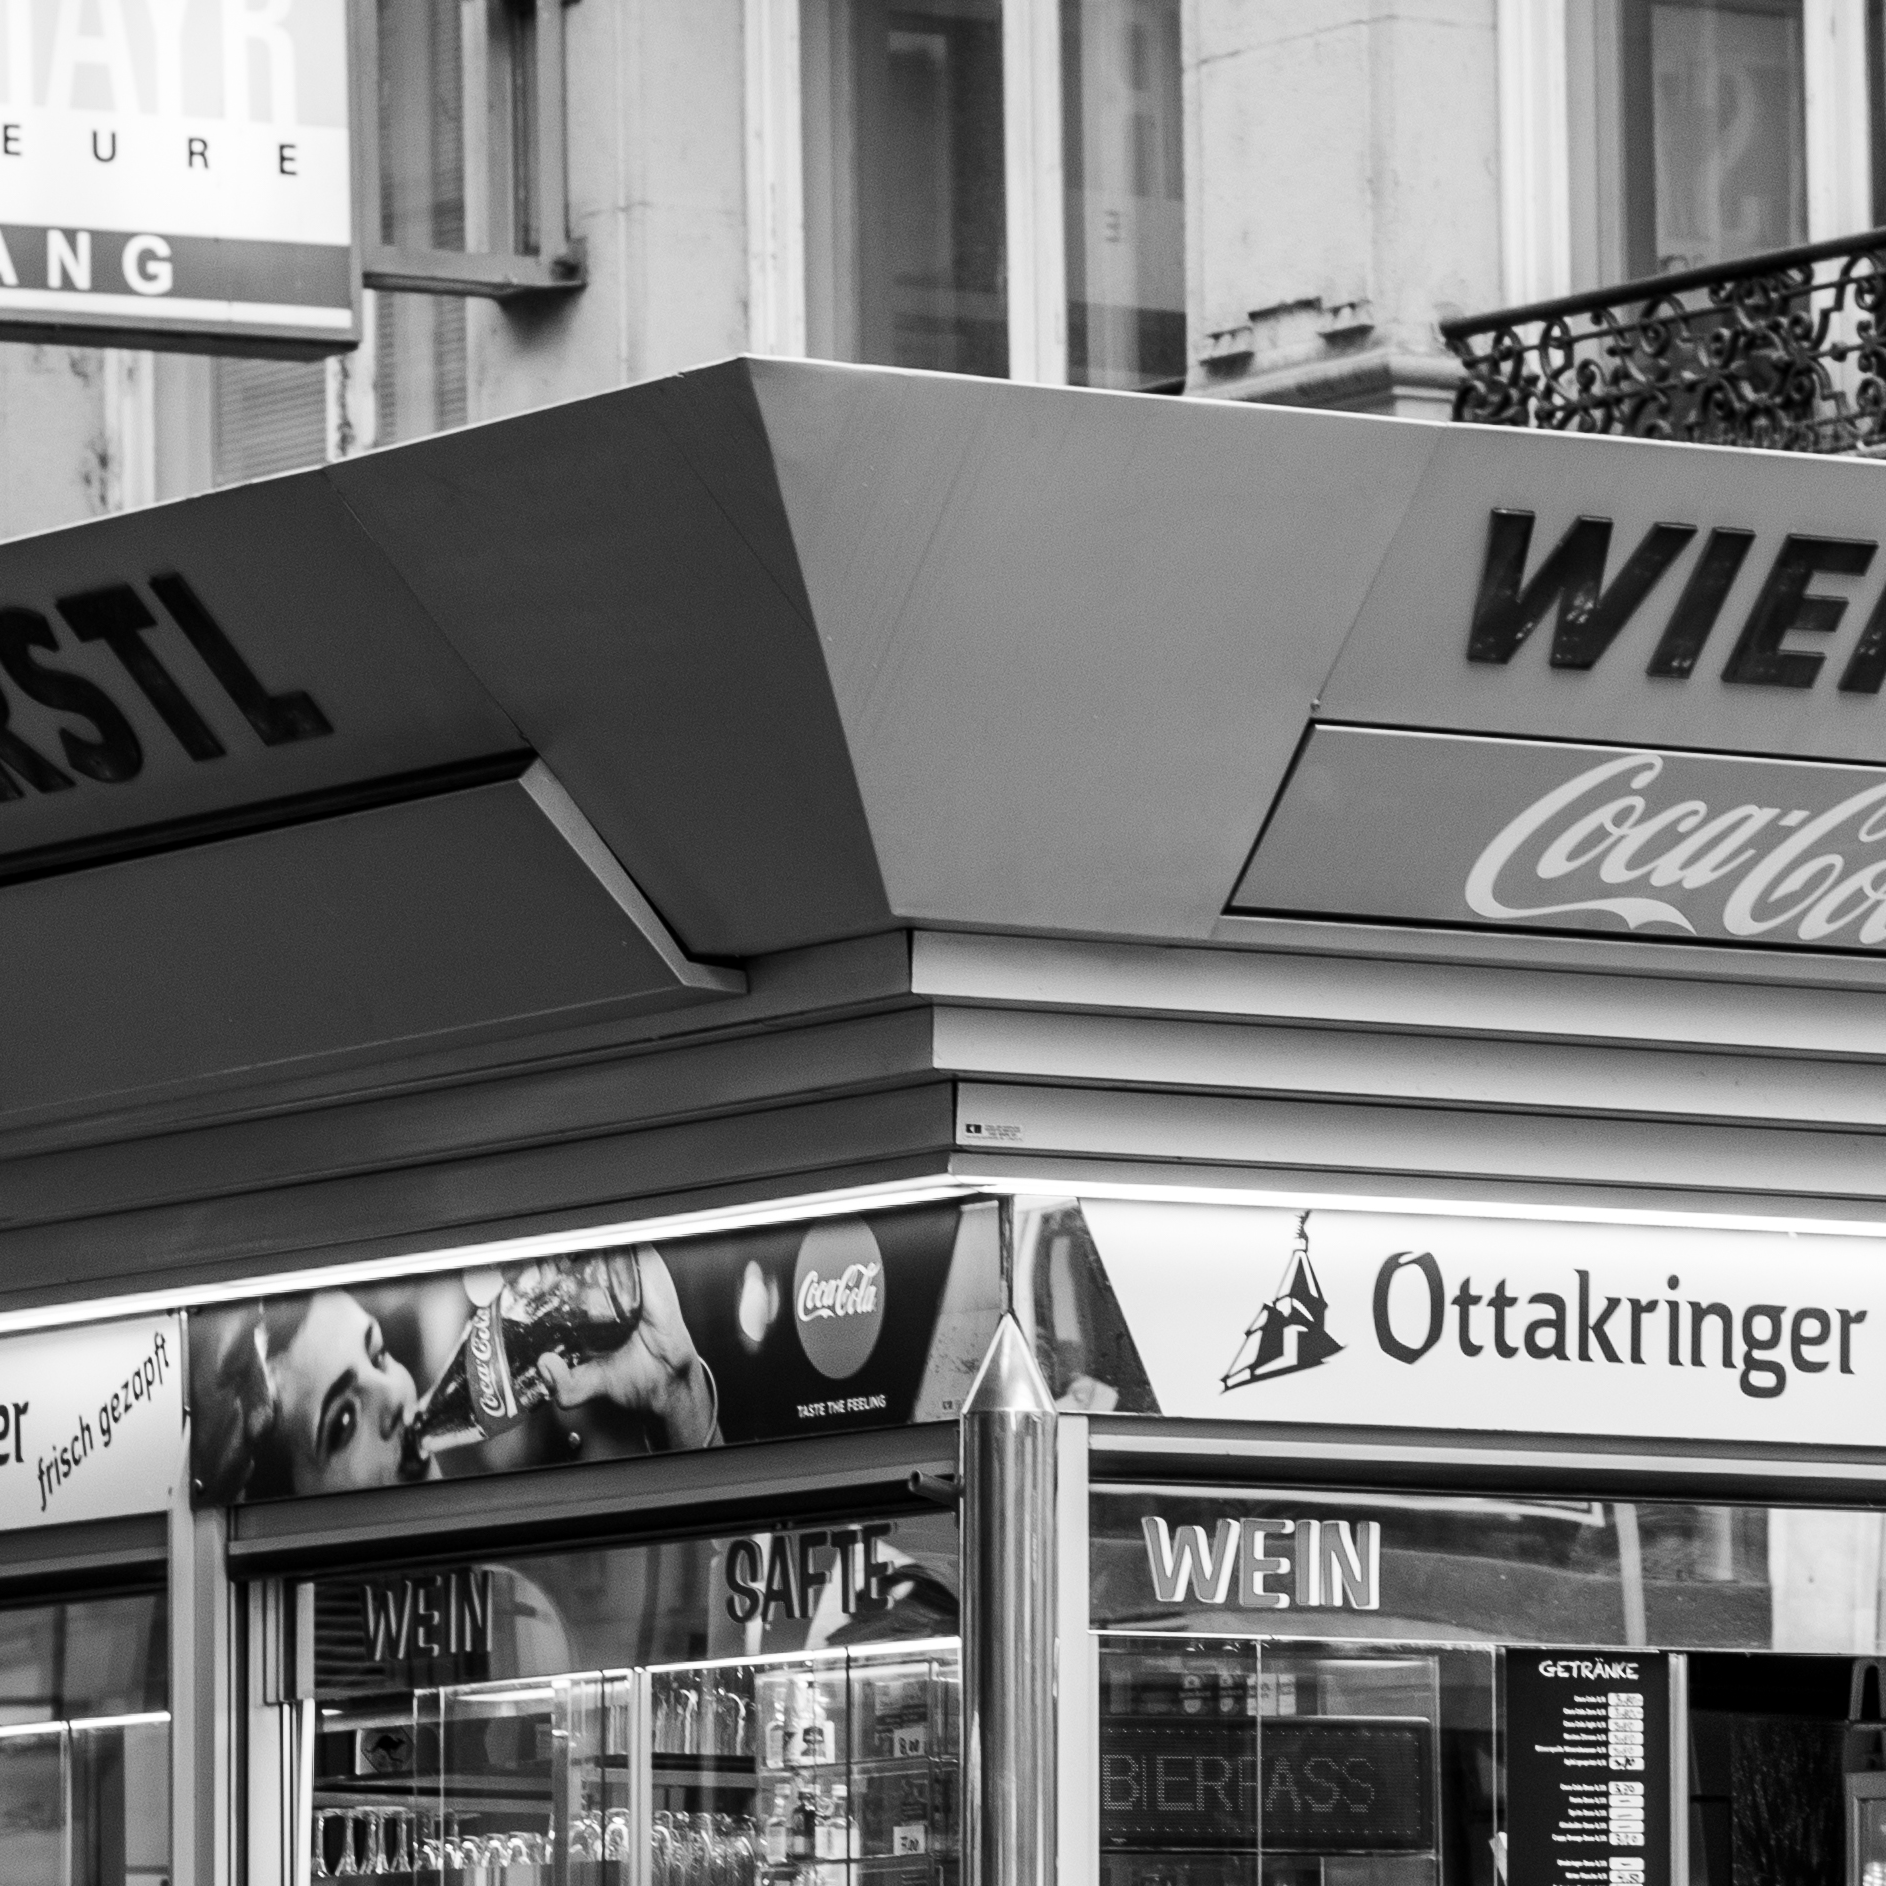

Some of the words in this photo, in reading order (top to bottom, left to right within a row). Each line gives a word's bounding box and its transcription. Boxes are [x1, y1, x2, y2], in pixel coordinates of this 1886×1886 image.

[1371, 1245, 1868, 1399] Ottakringer
[37, 1413, 94, 1511] frisch
[100, 1331, 171, 1446] gezapft
[797, 1401, 826, 1419] TASTE
[826, 1399, 846, 1415] THE
[846, 1393, 887, 1412] FEELING
[1140, 1515, 1382, 1610] WEIN
[360, 1568, 496, 1663] WEIN
[1538, 1659, 1640, 1680] GETRÄNKE
[1101, 1753, 1376, 1813] BIERFASS
